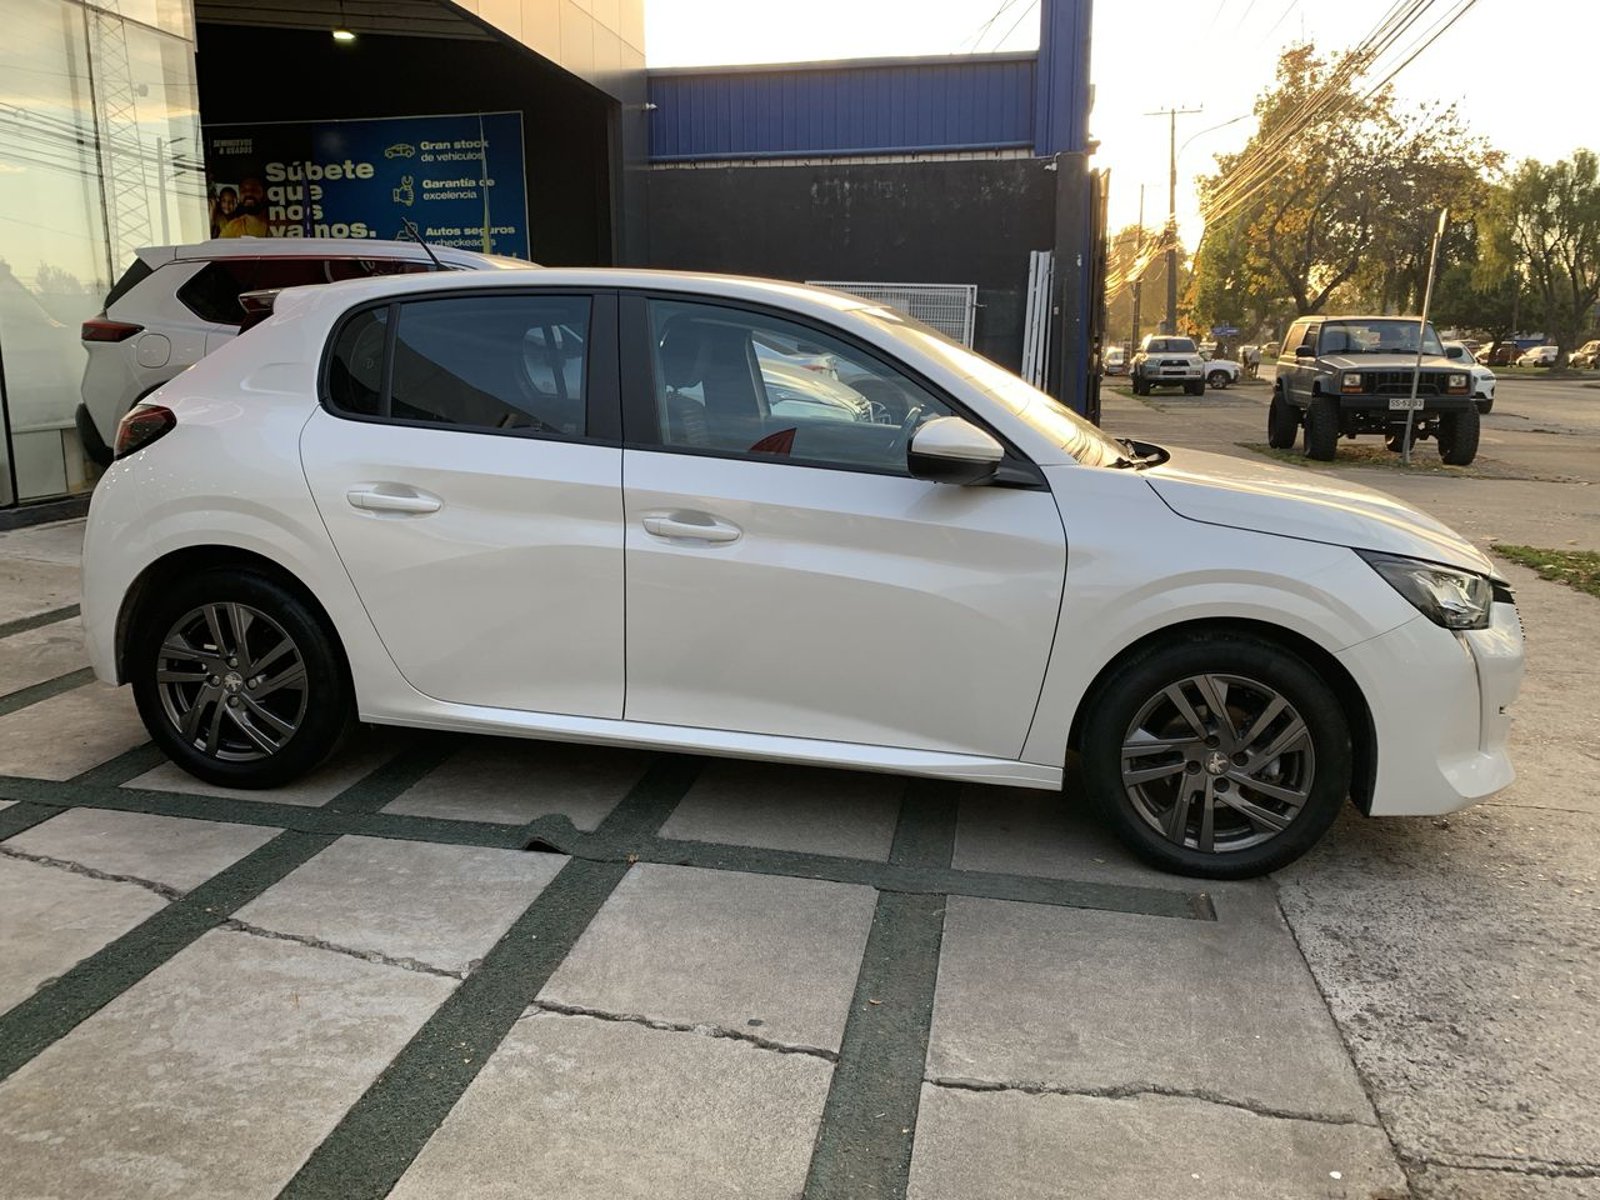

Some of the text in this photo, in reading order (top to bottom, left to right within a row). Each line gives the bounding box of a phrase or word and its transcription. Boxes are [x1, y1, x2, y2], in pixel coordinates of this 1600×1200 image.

[419, 140, 451, 151] Gran
[420, 152, 434, 163] de
[265, 159, 375, 182] Súbete
[421, 178, 476, 189] Garantía
[266, 184, 323, 206] que
[422, 190, 478, 201] excelencia
[268, 203, 324, 221] nos
[425, 227, 461, 237] Autos
